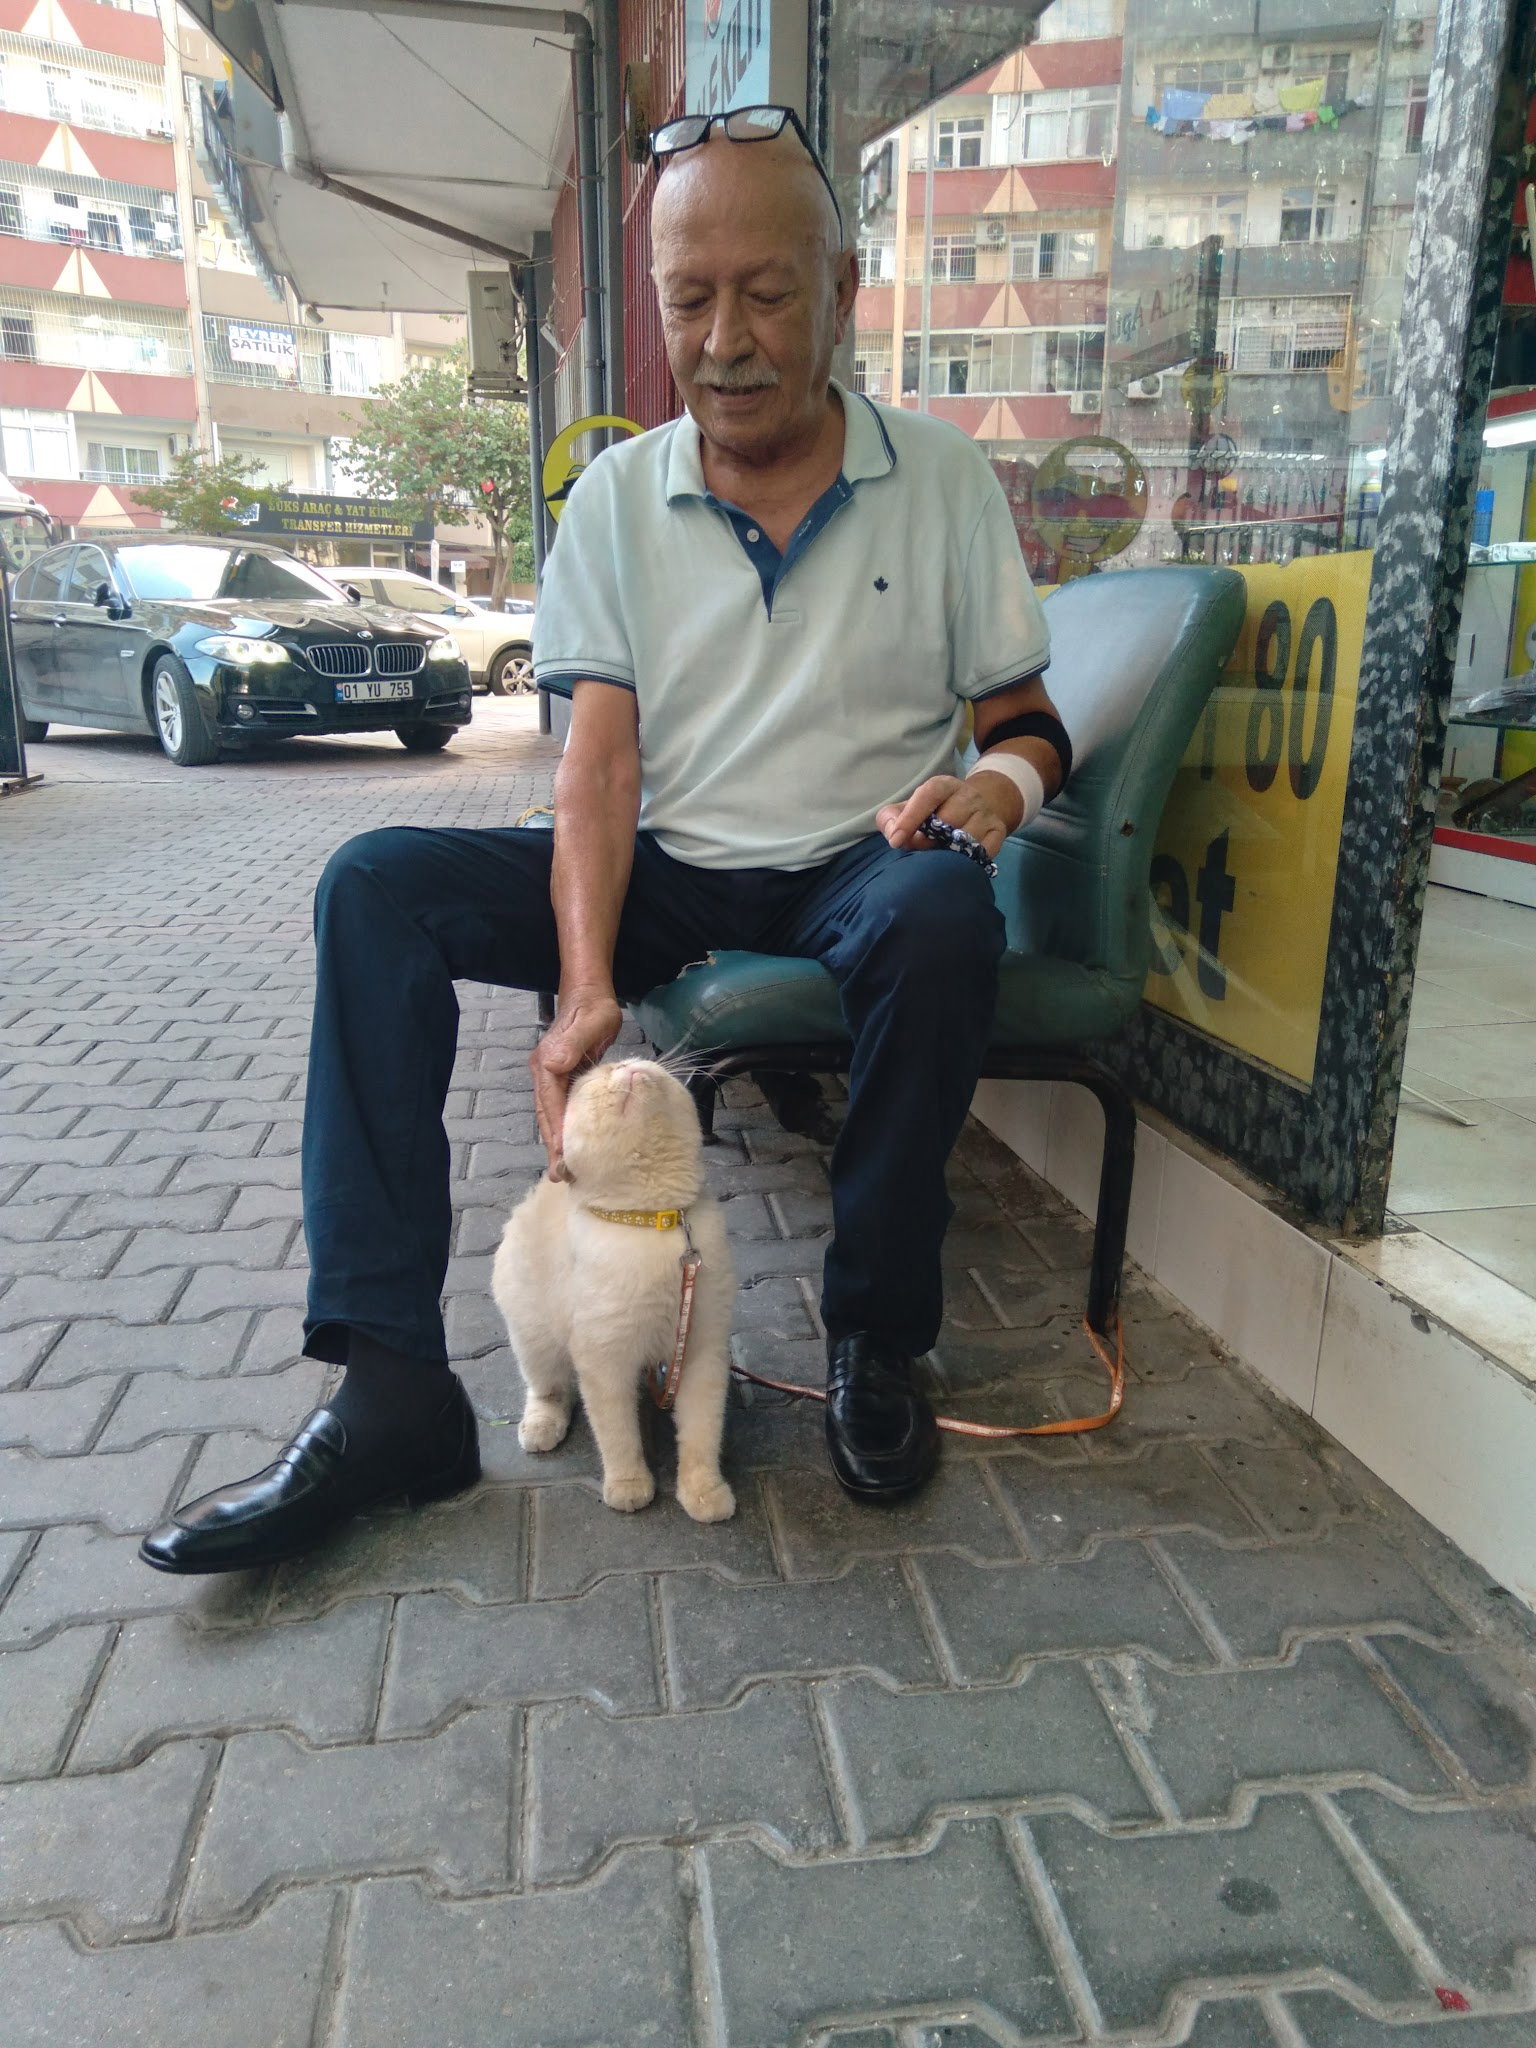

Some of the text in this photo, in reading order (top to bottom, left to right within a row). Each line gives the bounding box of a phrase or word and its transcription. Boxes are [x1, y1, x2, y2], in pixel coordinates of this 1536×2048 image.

[231, 338, 293, 355] SATILIK
[302, 500, 331, 518] ARAÇ
[334, 505, 343, 515] &
[345, 504, 366, 518] YAT
[281, 518, 342, 533] TRANSFER
[344, 684, 358, 699] 01
[367, 683, 381, 697] YU
[390, 682, 410, 696] 755
